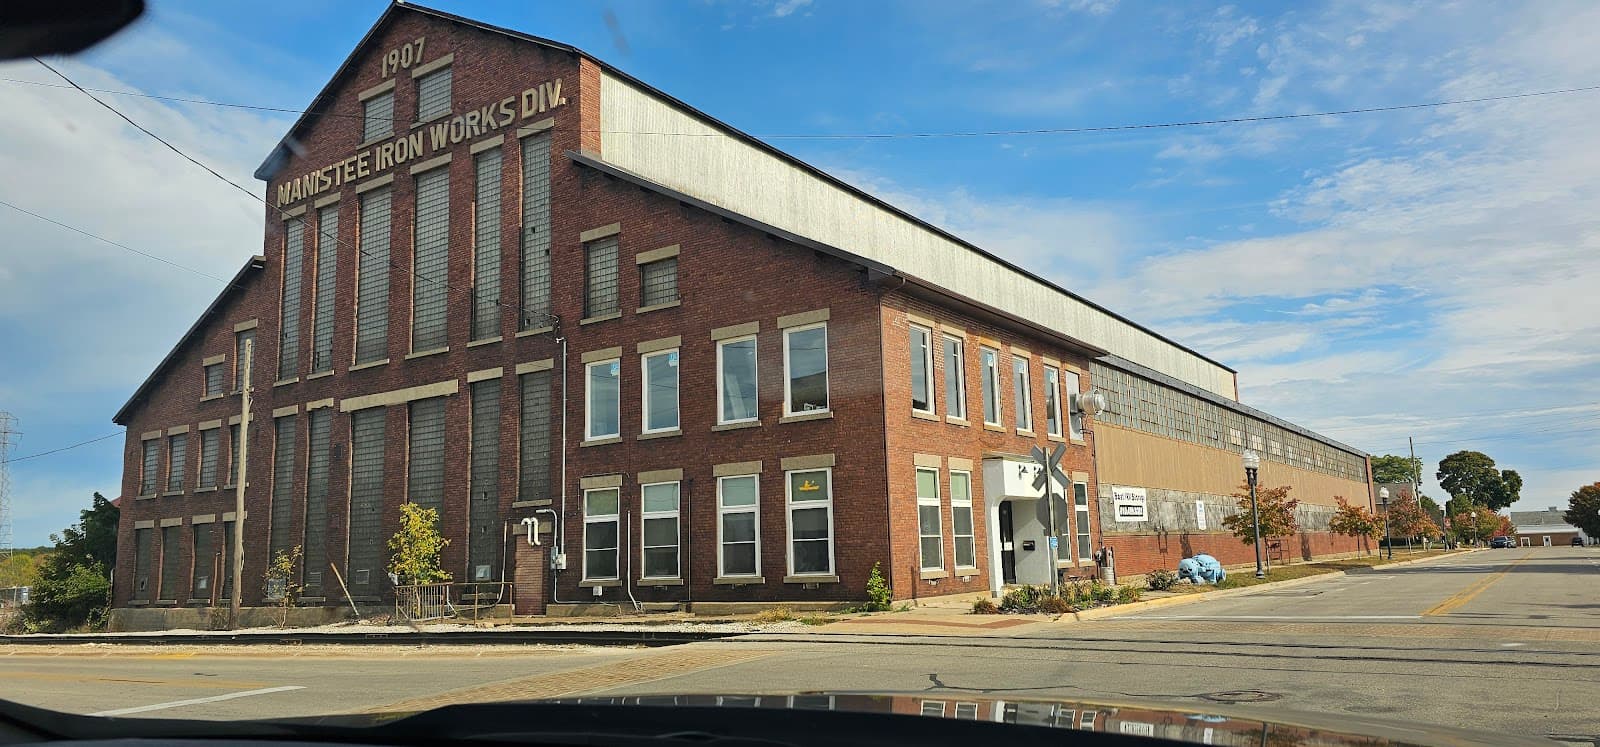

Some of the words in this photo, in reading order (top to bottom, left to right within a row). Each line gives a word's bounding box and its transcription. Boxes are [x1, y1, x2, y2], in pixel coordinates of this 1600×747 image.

[381, 37, 425, 78] 1907
[276, 151, 370, 208] MANISTEE
[375, 131, 424, 172] IRON
[429, 96, 516, 151] WORKS
[521, 78, 566, 119] DIV.
